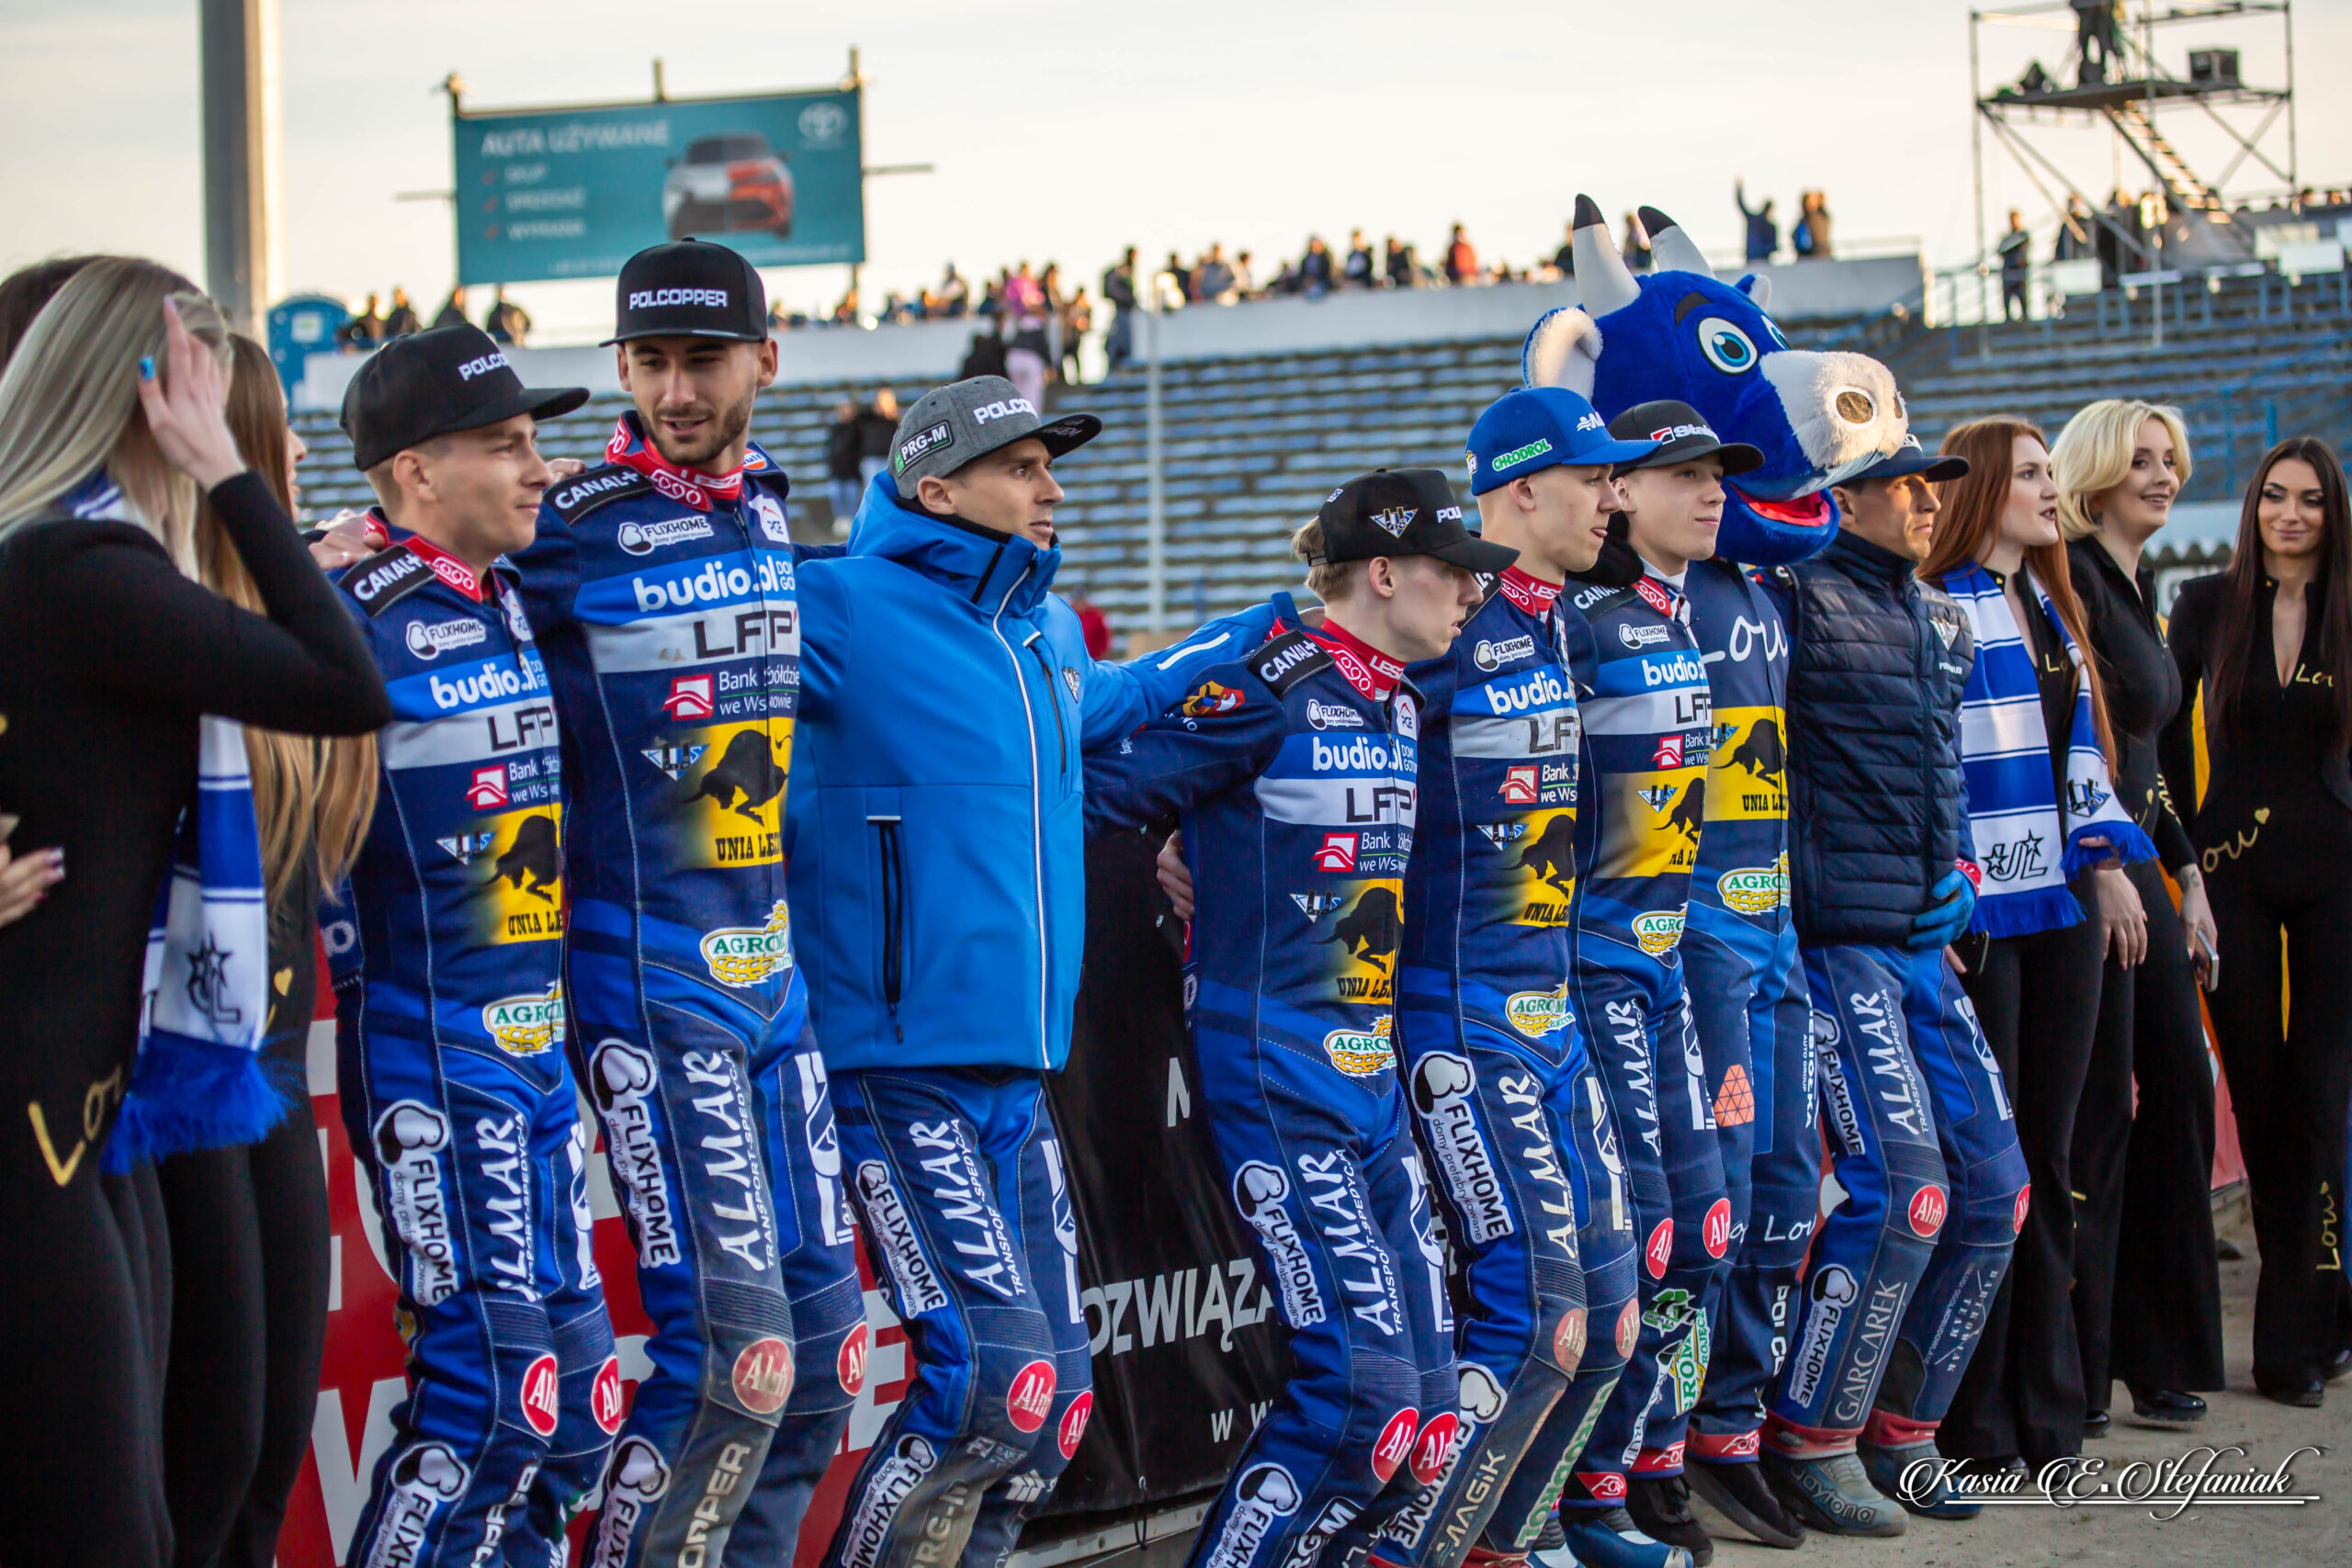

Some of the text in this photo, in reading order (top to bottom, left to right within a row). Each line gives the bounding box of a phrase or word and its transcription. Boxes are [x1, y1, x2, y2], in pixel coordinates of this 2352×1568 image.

[481, 128, 545, 157] AUTA
[629, 288, 728, 310] POLCOPPER
[901, 424, 946, 460] PRG-M
[1493, 439, 1551, 470] CHŁODROL
[555, 471, 639, 510] CANAL+
[645, 517, 708, 537] FLIXHOME
[354, 553, 424, 601] CANAL+
[694, 610, 793, 660] LFP
[1494, 637, 1532, 655] FLIXHOME
[1634, 626, 1667, 637] FLIXHOME
[1261, 640, 1319, 682] CANAL+
[718, 671, 757, 691] Bank
[719, 700, 740, 715] we
[487, 705, 554, 752] LFP
[1685, 734, 1703, 748] Bank
[508, 760, 537, 782] Bank
[1543, 764, 1568, 783] Bank
[1346, 787, 1412, 823] LFP
[1541, 791, 1556, 803] we
[1743, 795, 1770, 812] UNIA
[715, 836, 753, 862] UNIA
[1362, 831, 1390, 851] Bank
[1360, 861, 1376, 873] we
[508, 914, 542, 936] UNIA
[1336, 976, 1367, 998] UNIA
[1605, 1000, 1661, 1157] ALMAR
[1850, 992, 1919, 1135] ALMAR
[1882, 989, 1928, 1133] TRANSPORT-SPEDYCJA
[682, 1051, 766, 1271] ALMAR
[1432, 1118, 1483, 1240] domy prefabrykowane
[1444, 1104, 1510, 1237] FLIXHOME
[1498, 1074, 1577, 1258] ALMAR
[620, 1104, 677, 1266] FLIXHOME
[869, 1206, 884, 1236] domy
[909, 1122, 1012, 1297] ALMAR
[410, 1158, 456, 1303] FLIXHOME
[1297, 1152, 1395, 1337] ALMAR
[875, 1189, 944, 1312] FLIXHOME
[1264, 1207, 1323, 1325] FLIXHOME
[1270, 1247, 1300, 1326] prefabrykowane
[1801, 1305, 1839, 1405] FLIXHOME
[1836, 1279, 1903, 1423] GARCAREK
